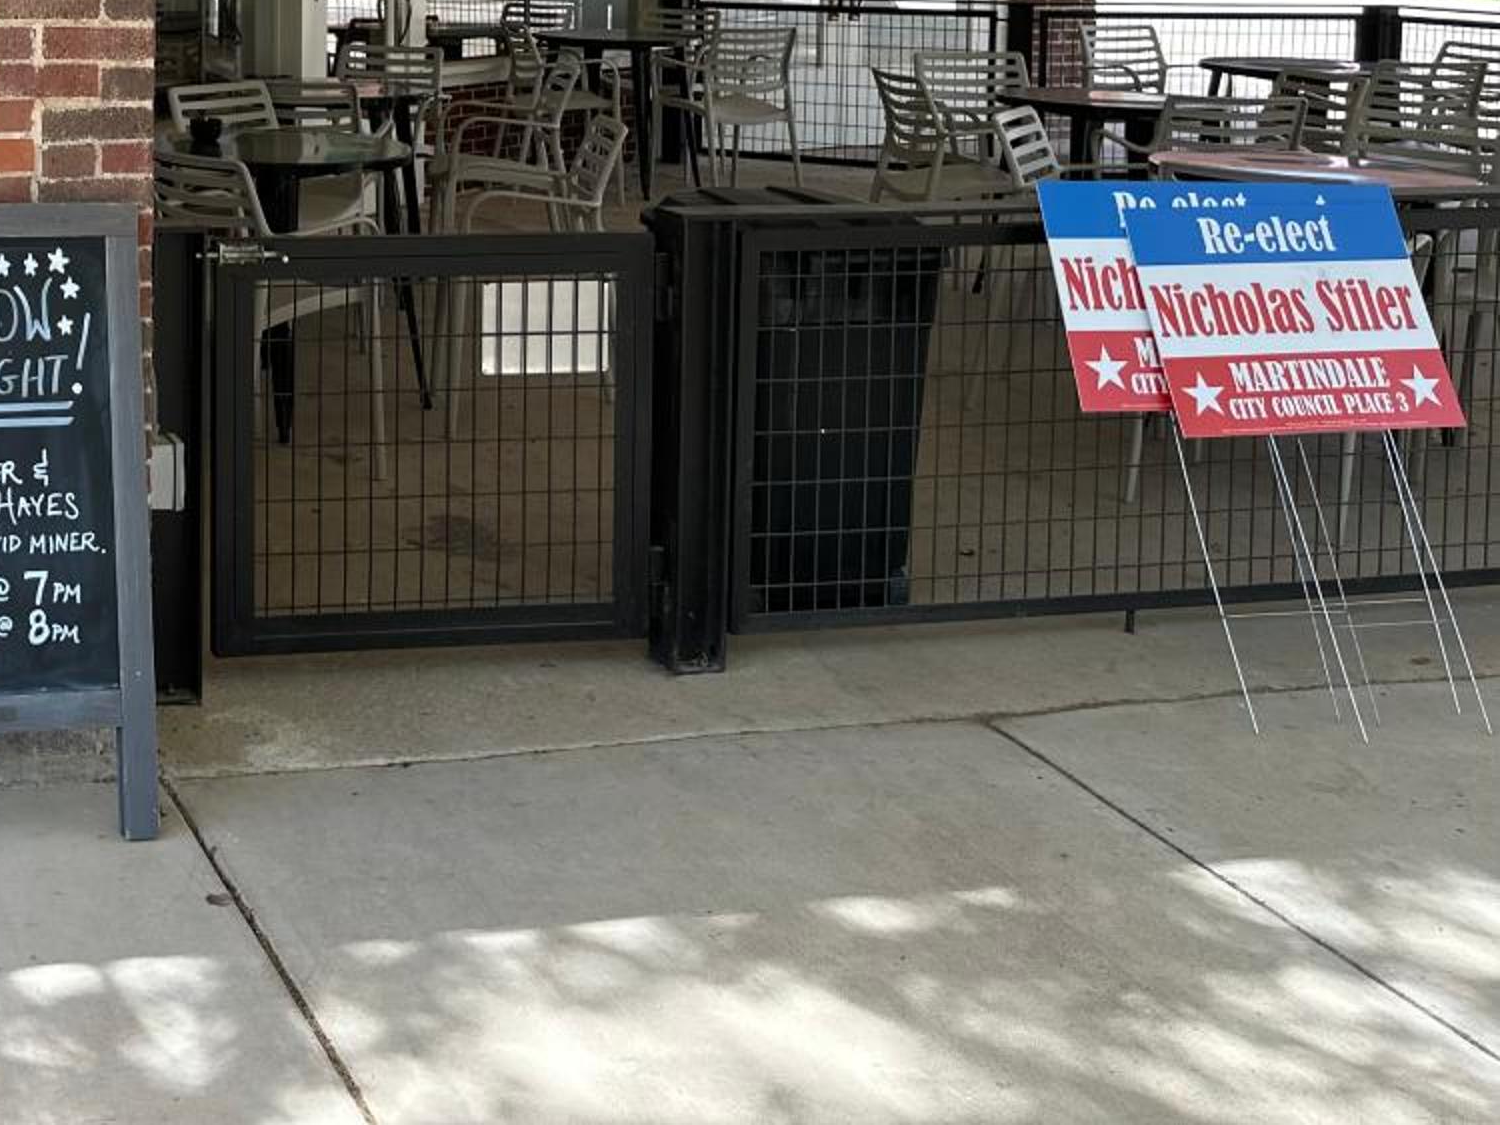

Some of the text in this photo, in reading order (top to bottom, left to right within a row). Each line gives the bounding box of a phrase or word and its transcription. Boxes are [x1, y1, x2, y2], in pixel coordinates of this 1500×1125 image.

[1197, 215, 1336, 254] Re-elect
[1060, 256, 1146, 311] Nich
[1149, 278, 1418, 338] Nicholas Stiler
[1228, 357, 1391, 393] MARTINDALE
[1229, 392, 1409, 419] CITY COUNCIL PLACE 3
[33, 448, 49, 487] &
